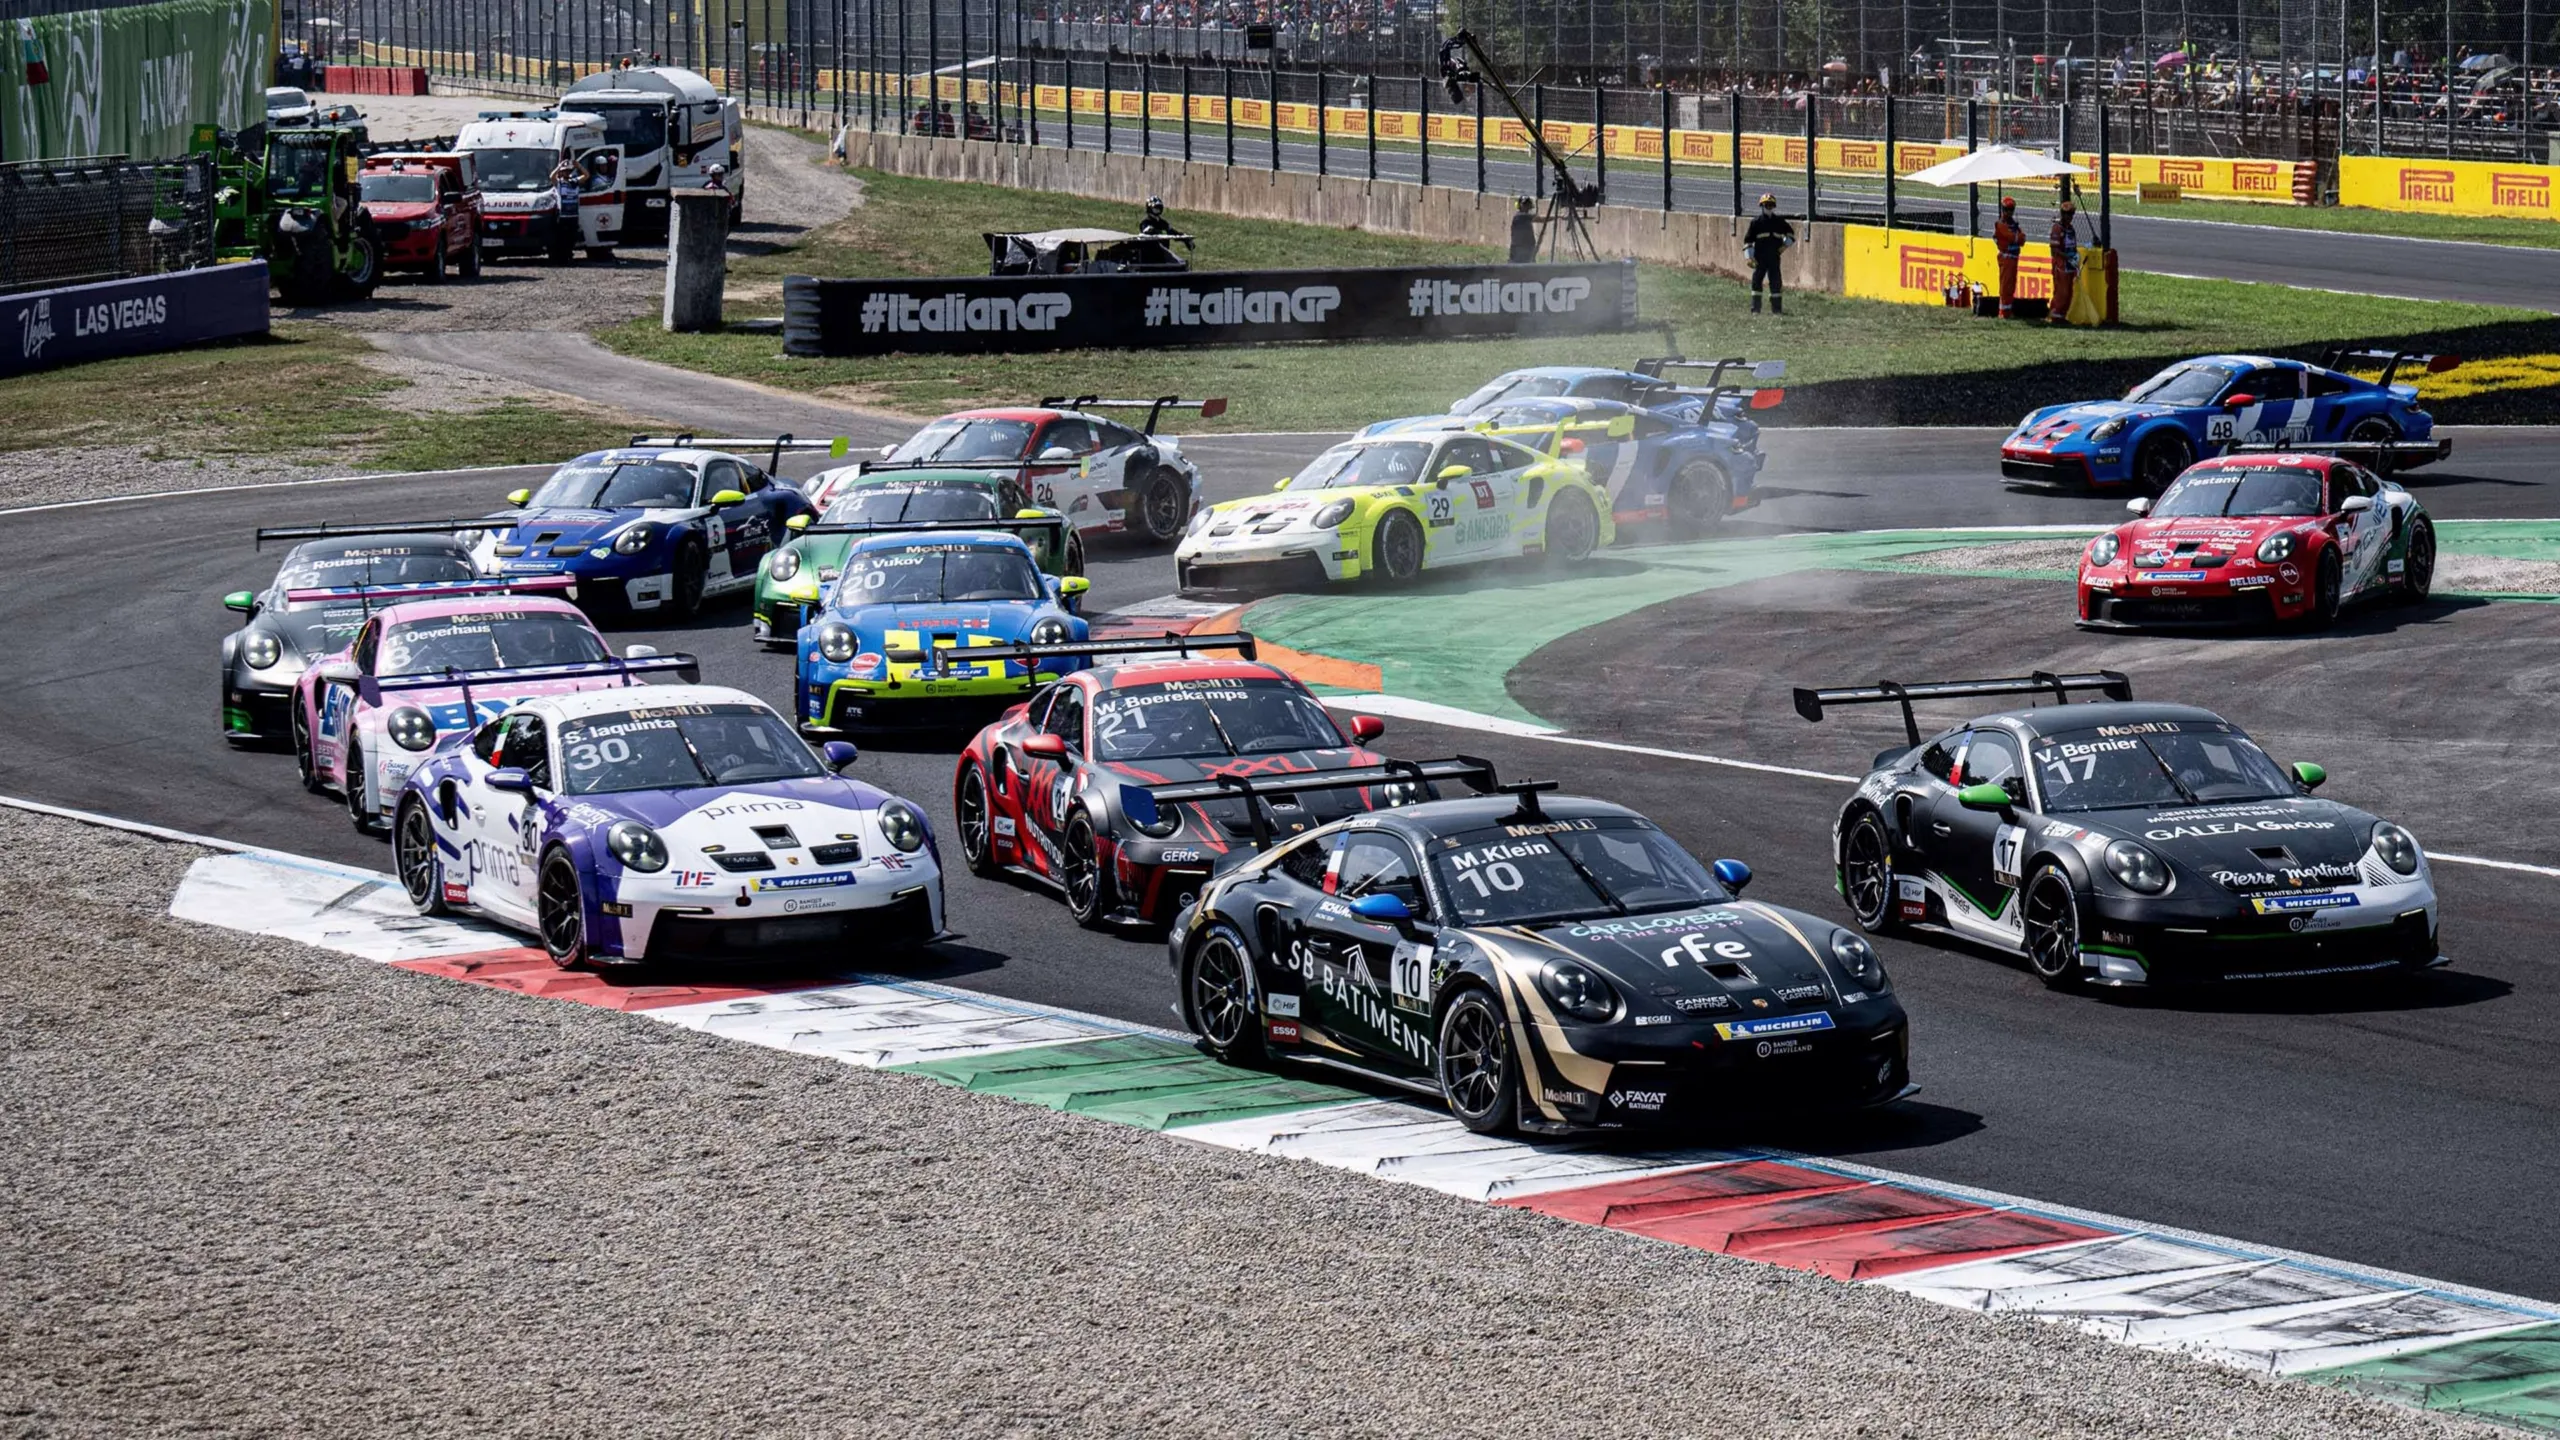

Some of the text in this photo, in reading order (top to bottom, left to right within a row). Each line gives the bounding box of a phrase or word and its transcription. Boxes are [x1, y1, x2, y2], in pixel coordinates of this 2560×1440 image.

[1242, 101, 1262, 120] PIRELLI
[1344, 111, 1366, 130] PIRELLI
[1380, 114, 1403, 134] PIRELLI
[1683, 133, 1713, 157] PIRELLI
[1841, 143, 1877, 168] PIRELLI
[2233, 162, 2278, 191] PIRELLI
[2400, 168, 2455, 202] PIRELLI
[2492, 173, 2550, 208] PIRELLI
[1145, 285, 1341, 327] #ItalianGP
[1409, 276, 1591, 318] #ItalianGP
[76, 294, 167, 337] LAS VEGAS
[860, 291, 1072, 334] #ItalianGP
[2211, 420, 2233, 439] 48
[2222, 465, 2261, 473] Mobil
[1036, 484, 1053, 501] 26
[1431, 497, 1450, 518] 29
[712, 524, 721, 544] 5
[344, 547, 391, 558] Mobil
[906, 544, 952, 554] Mobil
[312, 556, 382, 571] Rousset
[853, 556, 924, 574] R. Vukov
[843, 571, 886, 596] 20
[451, 613, 505, 624] Mobil
[405, 624, 491, 642] Oeverhaus
[1163, 678, 1222, 691] Mobil
[1094, 689, 1248, 717] W. Boerekamps
[628, 705, 690, 720] Mobil
[564, 718, 678, 745] S. Iaquinta
[1096, 706, 1148, 740] 21
[2096, 722, 2158, 737] Mobil
[570, 738, 631, 771] 30
[2034, 738, 2138, 764] V. Bernier
[2046, 753, 2098, 785] 17
[698, 800, 805, 820] prima
[2157, 804, 2276, 818] CENTRE PORSCHE
[2249, 807, 2300, 817] BASTIA
[522, 819, 539, 853] 30
[1504, 820, 1572, 838] Mobil
[2144, 821, 2254, 841] GALEA
[463, 838, 520, 887] prima
[1161, 850, 1200, 863] GERIS
[1450, 841, 1550, 871] M.Klein
[1999, 837, 2017, 873] 17
[780, 874, 848, 887] MICHELIN
[1456, 861, 1525, 898] 10
[2211, 869, 2278, 886] Pierre
[447, 889, 468, 899] ESSO
[1911, 888, 1923, 897] HIF
[2263, 889, 2303, 897] TRAITEUR
[1903, 906, 1923, 916] ESSO
[2285, 896, 2351, 908] MICHELIN
[1569, 911, 1740, 937] CAR LOVERS
[1624, 928, 1658, 939] THE
[1665, 924, 1710, 935] ROAD
[1660, 932, 1752, 968] rfe
[1287, 940, 1315, 980] SB
[1398, 957, 1422, 998] 10
[1674, 993, 1728, 1005] CANNES
[1777, 984, 1819, 996] CANNES
[1779, 989, 1823, 1001] KARTING
[1282, 1001, 1297, 1010] HIF
[1676, 1001, 1730, 1011] KARTING
[1323, 964, 1431, 1067] BATIMENT
[1272, 1025, 1297, 1036] ESSO
[1752, 1017, 1822, 1033] MICHELIN
[1773, 1043, 1813, 1055] HAVILLAND
[1544, 1088, 1573, 1104] Mobil
[1626, 1090, 1667, 1104] FAYAT
[1628, 1102, 1661, 1111] BATIMENT
